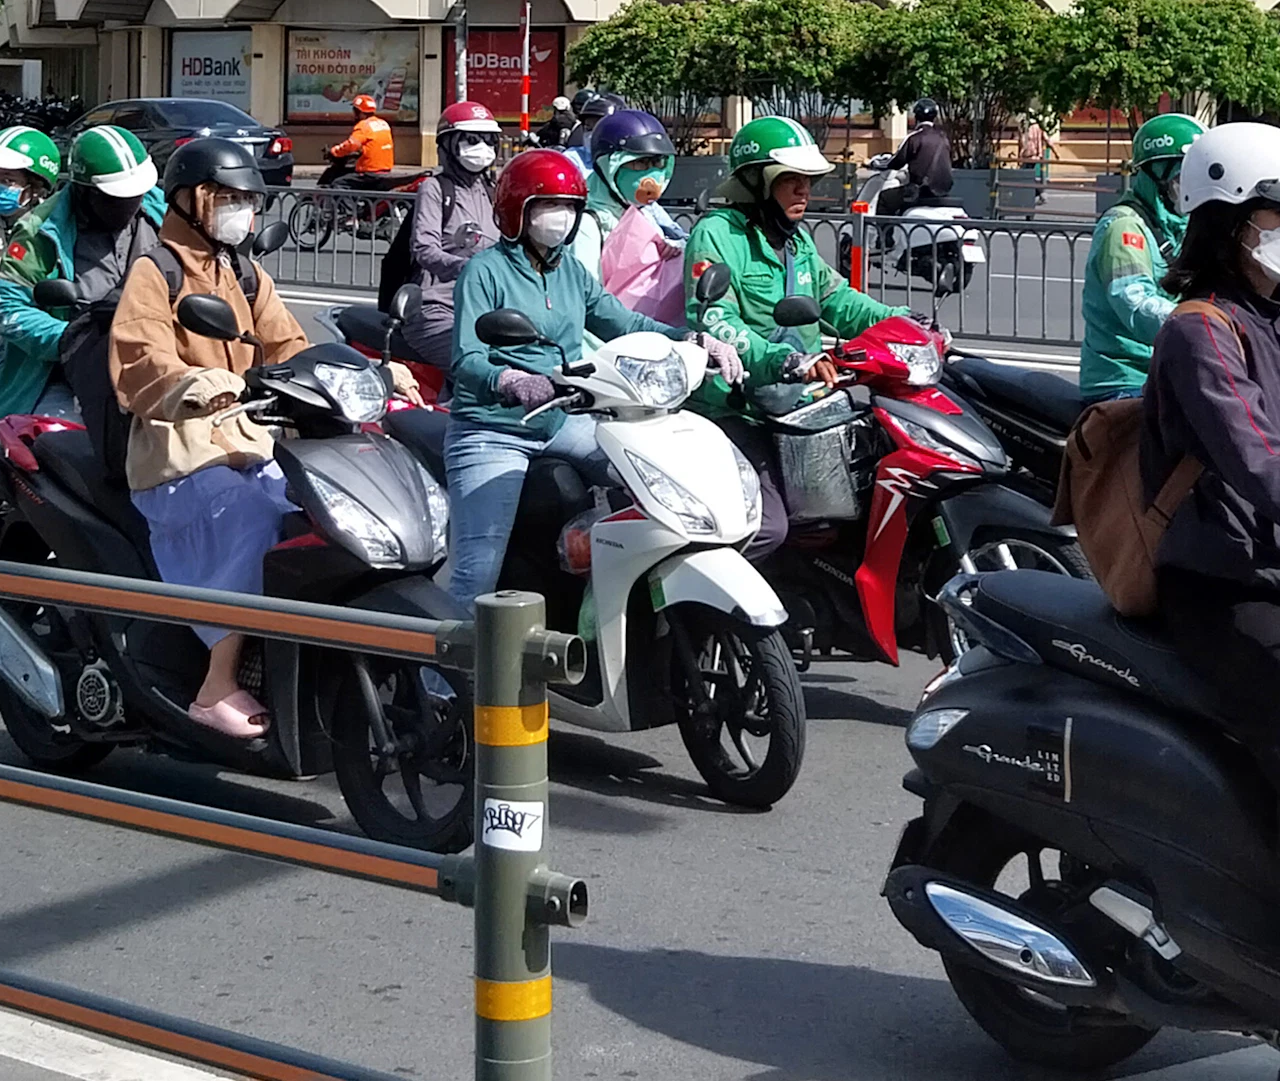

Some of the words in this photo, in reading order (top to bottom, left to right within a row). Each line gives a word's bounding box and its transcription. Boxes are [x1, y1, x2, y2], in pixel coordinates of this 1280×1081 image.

[182, 57, 240, 76] HDBank
[733, 140, 760, 158] Grab
[1142, 134, 1174, 151] Grab
[38, 155, 59, 176] Grab
[702, 307, 751, 355] Grab
[595, 537, 625, 550] HONDA
[813, 557, 855, 588] HONDA
[1052, 639, 1141, 688] Grande
[962, 744, 1045, 772] Grande
